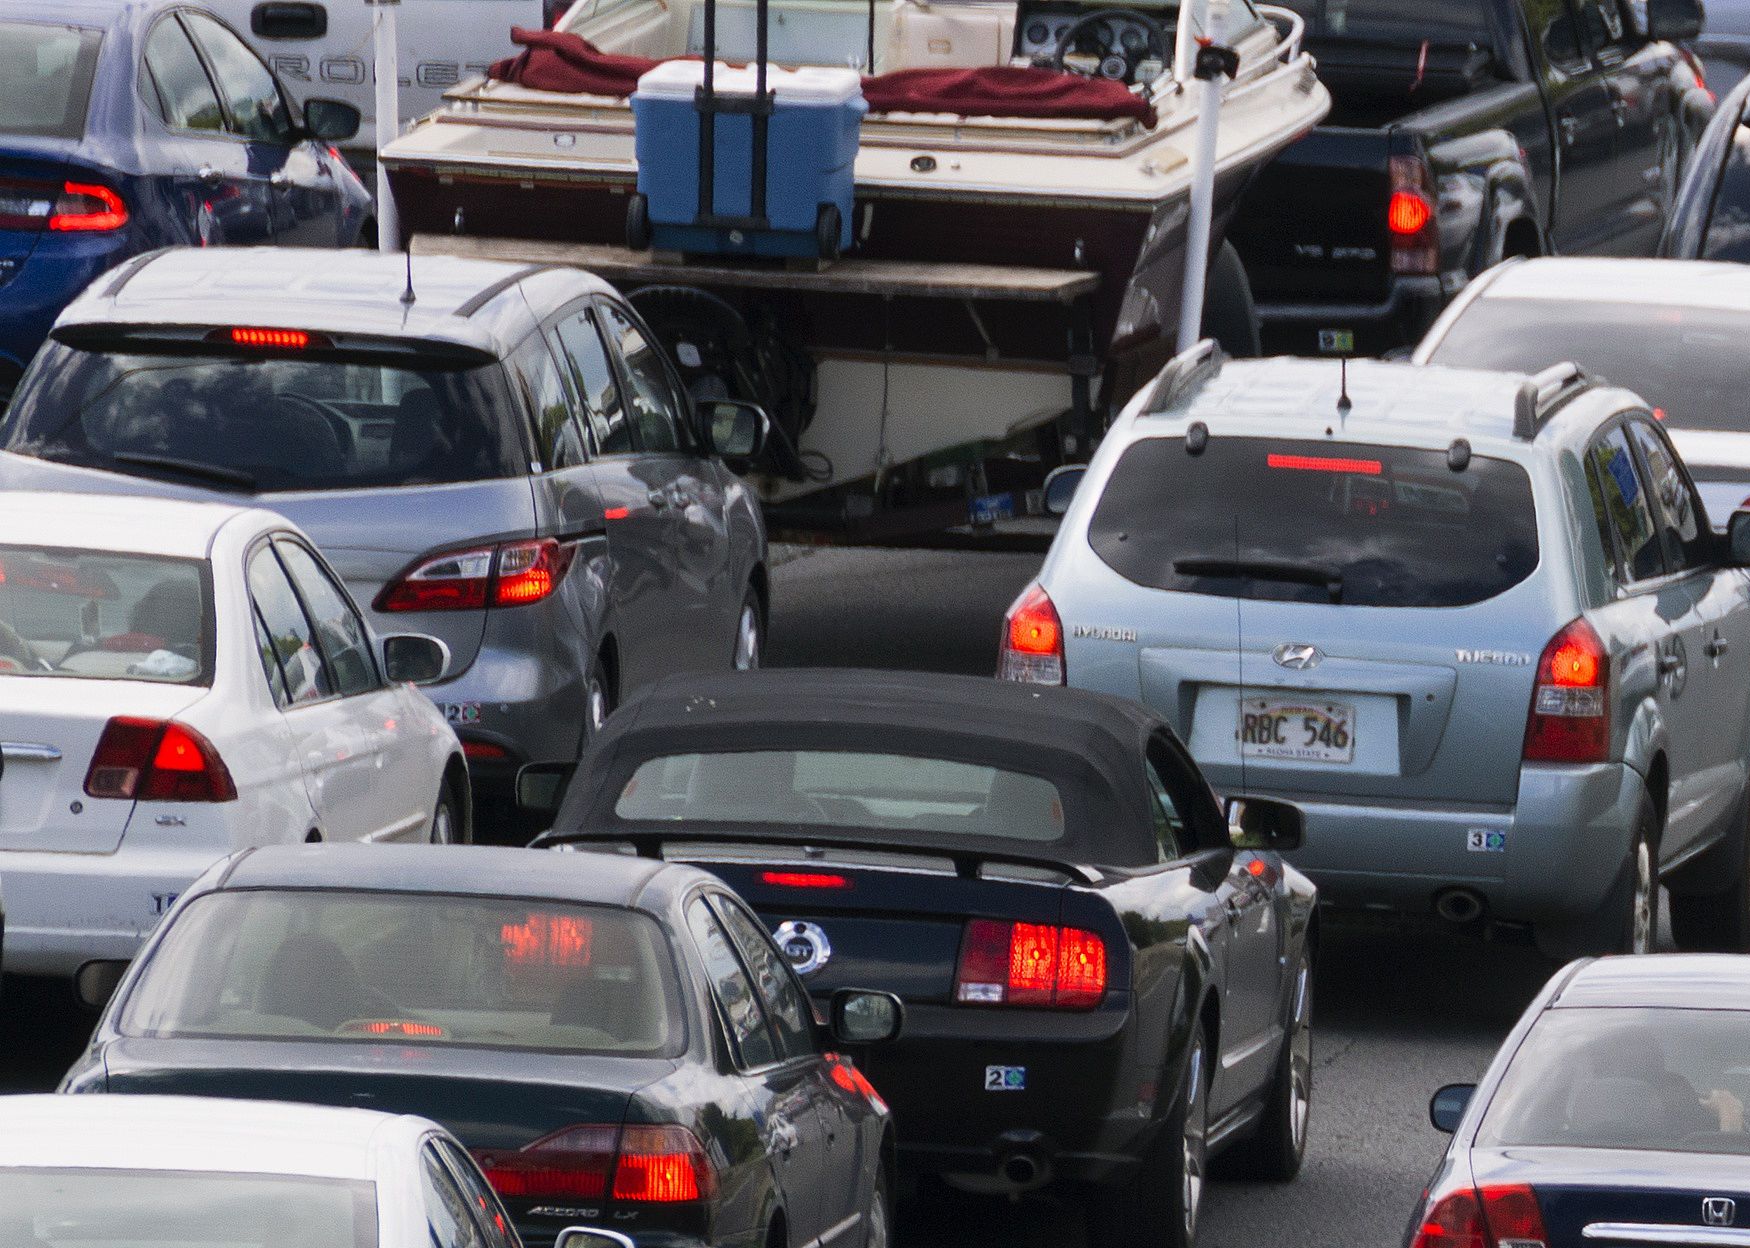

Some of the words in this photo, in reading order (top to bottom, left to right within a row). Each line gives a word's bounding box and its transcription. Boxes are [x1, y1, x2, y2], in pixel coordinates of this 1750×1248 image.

[1242, 713, 1288, 744] RBC
[1303, 716, 1349, 749] 546
[1472, 833, 1483, 847] 3
[989, 1070, 1002, 1087] 2
[527, 1206, 600, 1218] ACCORD
